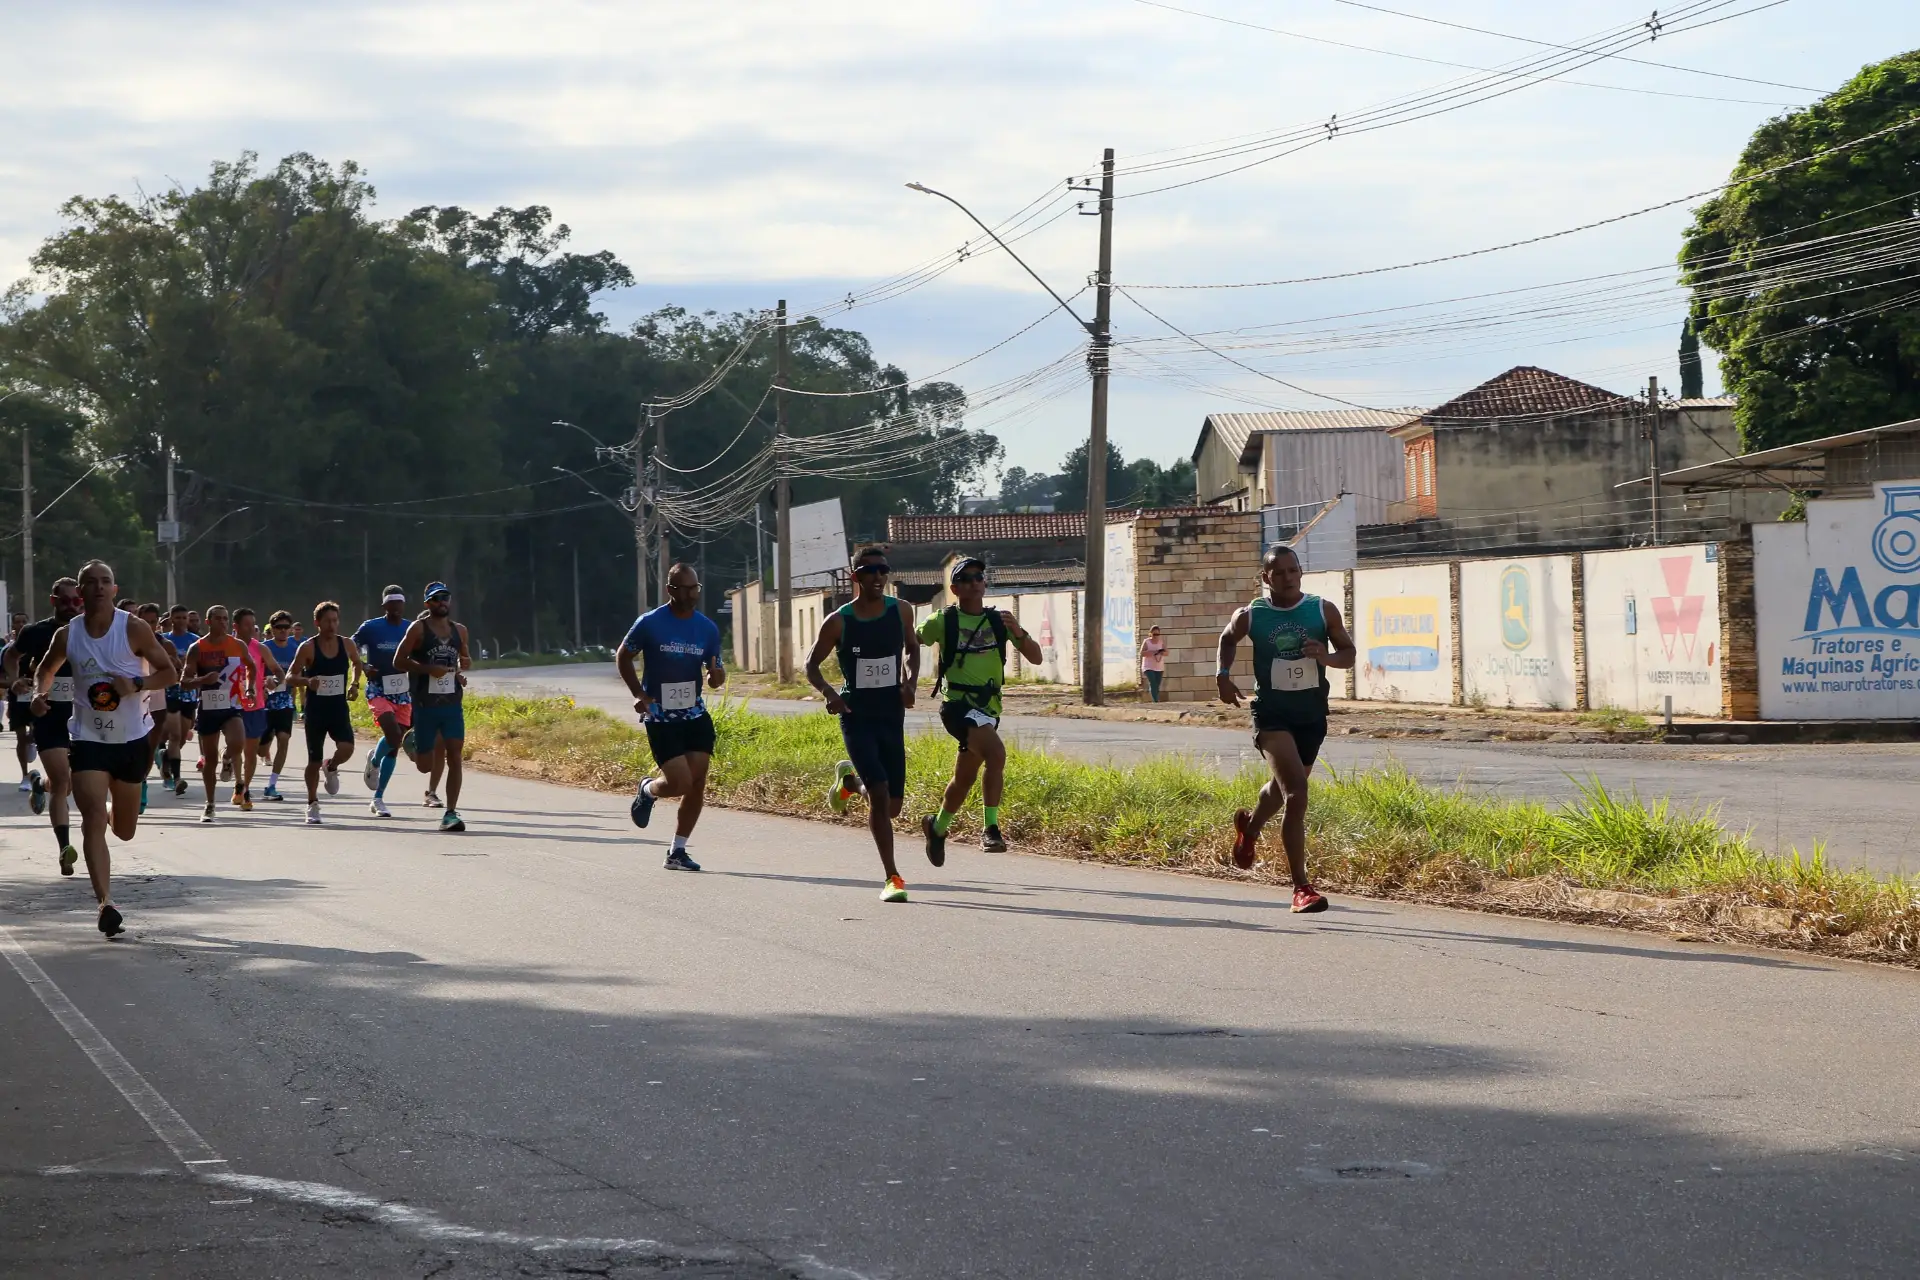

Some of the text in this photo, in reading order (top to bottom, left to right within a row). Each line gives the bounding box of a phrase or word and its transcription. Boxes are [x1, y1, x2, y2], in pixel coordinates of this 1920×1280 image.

[1804, 566, 1920, 632] Ma
[1812, 637, 1901, 654] Tratores e
[865, 664, 889, 677] 318
[1287, 667, 1304, 679] 19
[1782, 657, 1864, 679] Máquinas
[322, 680, 340, 689] 322
[208, 693, 225, 702] 180
[669, 686, 690, 699] 215
[94, 717, 114, 731] 94
